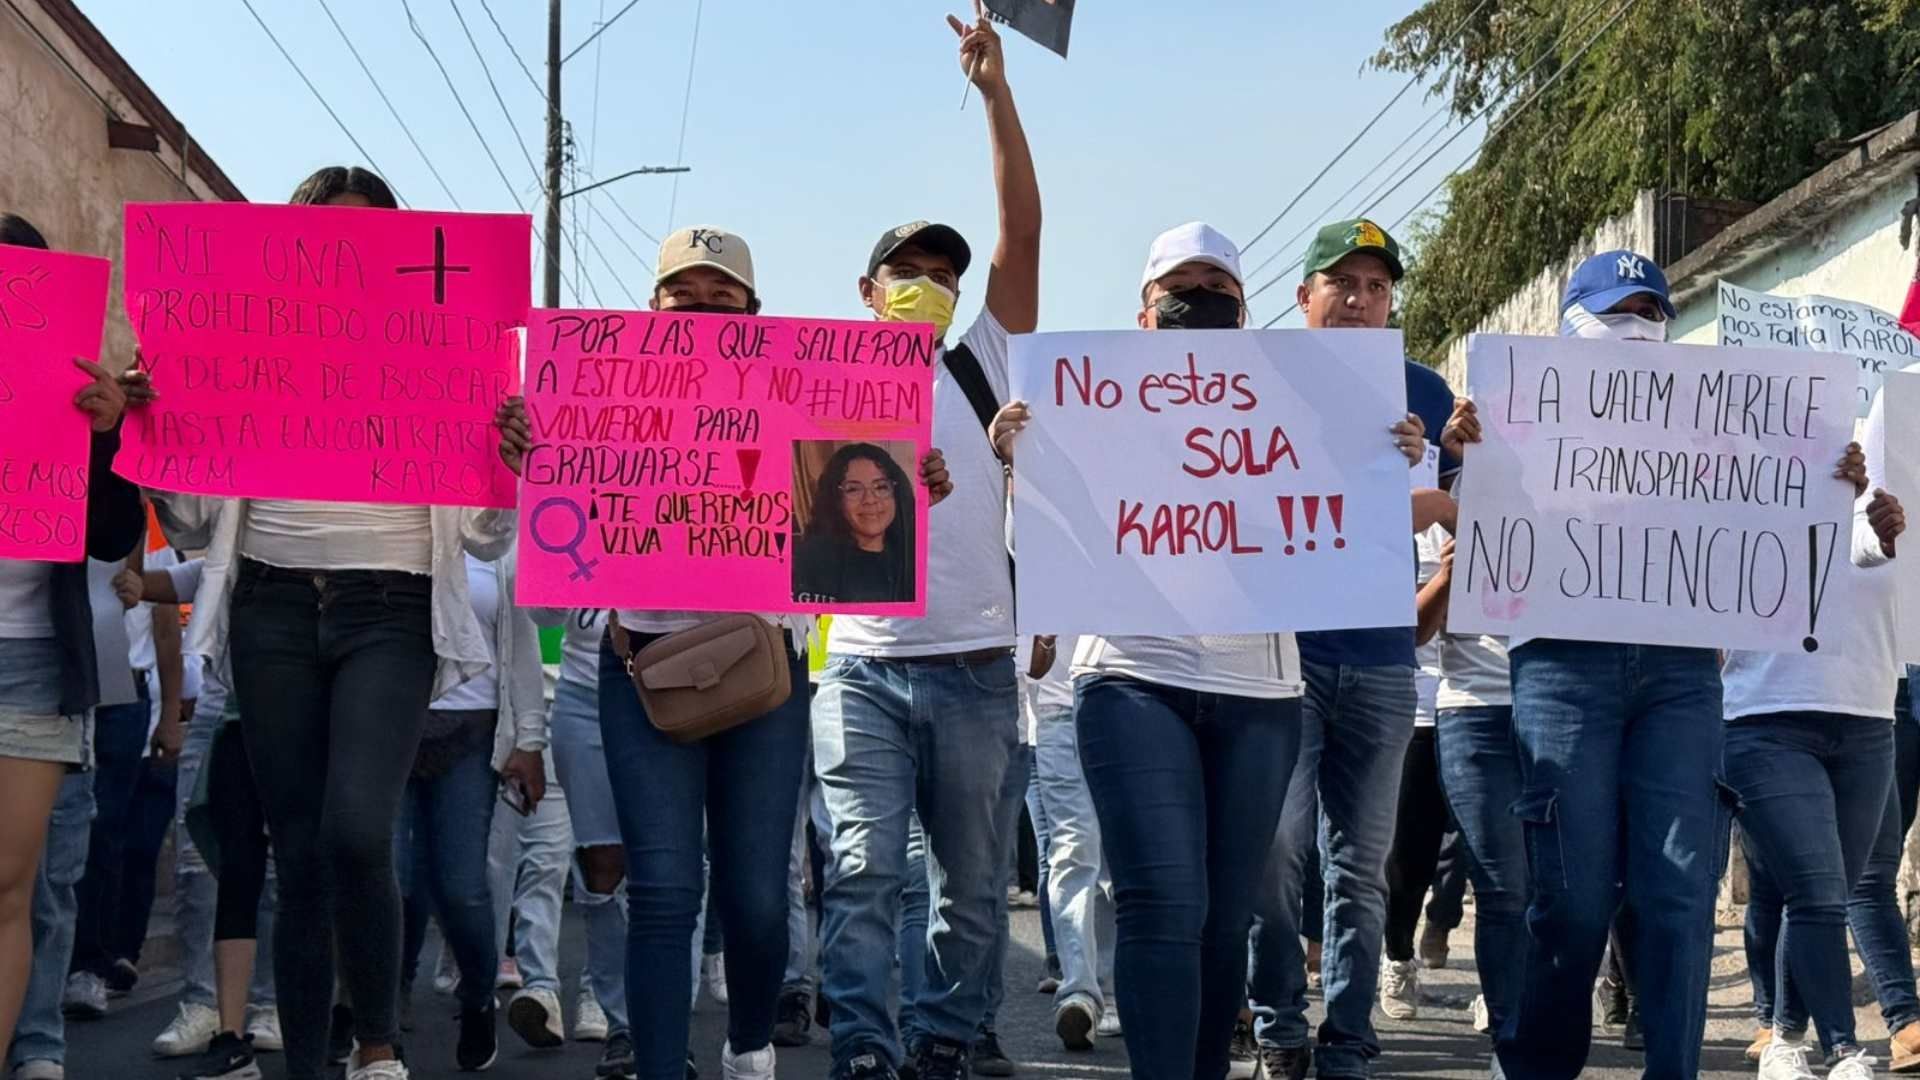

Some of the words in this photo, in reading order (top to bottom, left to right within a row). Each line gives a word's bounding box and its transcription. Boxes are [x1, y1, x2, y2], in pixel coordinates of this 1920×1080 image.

[263, 233, 364, 289] UNA
[689, 229, 722, 254] KC
[1616, 254, 1646, 279] NY
[137, 288, 367, 341] PROHIBIDO
[1721, 287, 1751, 312] No
[1760, 302, 1858, 322] estamos
[547, 314, 626, 354] POR
[640, 316, 695, 356] LAS
[718, 320, 776, 360] QUE
[794, 326, 933, 368] SALIERON
[1722, 314, 1760, 338] nos
[1841, 322, 1920, 358] KAROL
[182, 355, 302, 398] DEJAR
[320, 363, 353, 401] DE
[381, 364, 512, 407] BUSCAR
[536, 359, 557, 394] A
[572, 358, 709, 400] ESTUDIAR
[734, 361, 754, 400] Y
[768, 366, 803, 405] NO
[804, 378, 921, 424] #UAEM
[1055, 356, 1123, 408] No
[1139, 353, 1258, 413] estas
[1507, 345, 1561, 424] LA
[1590, 370, 1674, 430] UAEM
[1694, 369, 1826, 441] MERECE
[140, 411, 262, 449] HASTA
[281, 414, 500, 457] ENCONTRART
[531, 403, 674, 443] VOLVIERON
[694, 405, 760, 443] PARA
[1182, 426, 1300, 479] SOLA
[1546, 437, 1808, 509] TRANSPARENCIA
[137, 454, 236, 489] UAEM
[372, 458, 508, 498] KAROL
[655, 491, 790, 526] QUEREMOS
[600, 524, 662, 554] VIVA
[1467, 516, 1535, 594] NO
